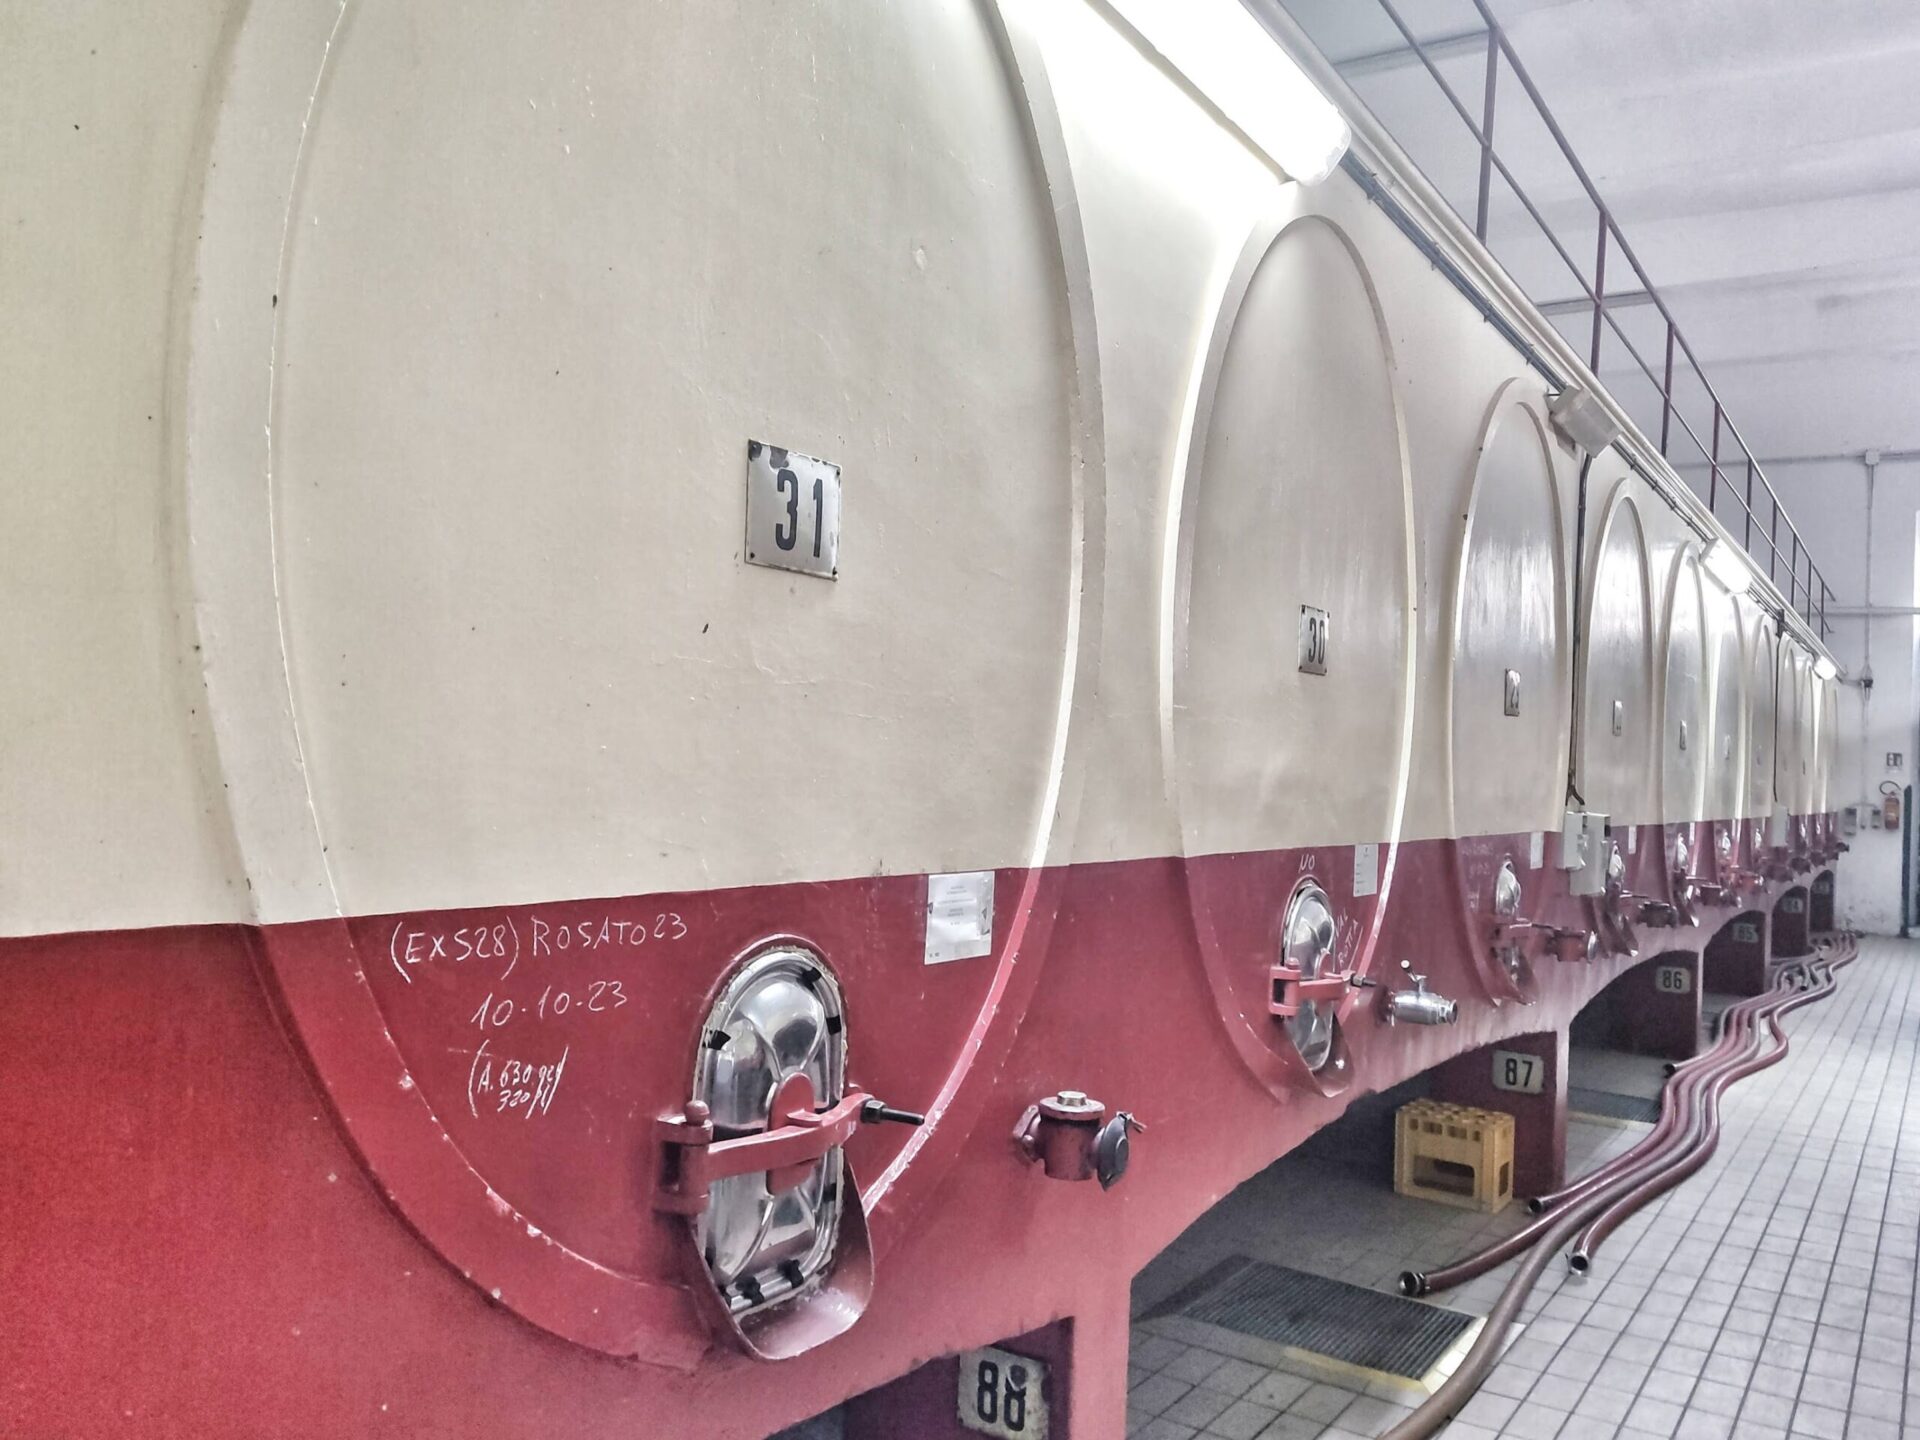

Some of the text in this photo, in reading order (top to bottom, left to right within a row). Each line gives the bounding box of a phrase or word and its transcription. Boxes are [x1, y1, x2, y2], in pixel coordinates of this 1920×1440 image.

[775, 468, 823, 558] 31
[1308, 617, 1326, 665] 30
[1663, 970, 1682, 990] 86
[1505, 1058, 1533, 1088] 87
[977, 1360, 1027, 1431] 88
